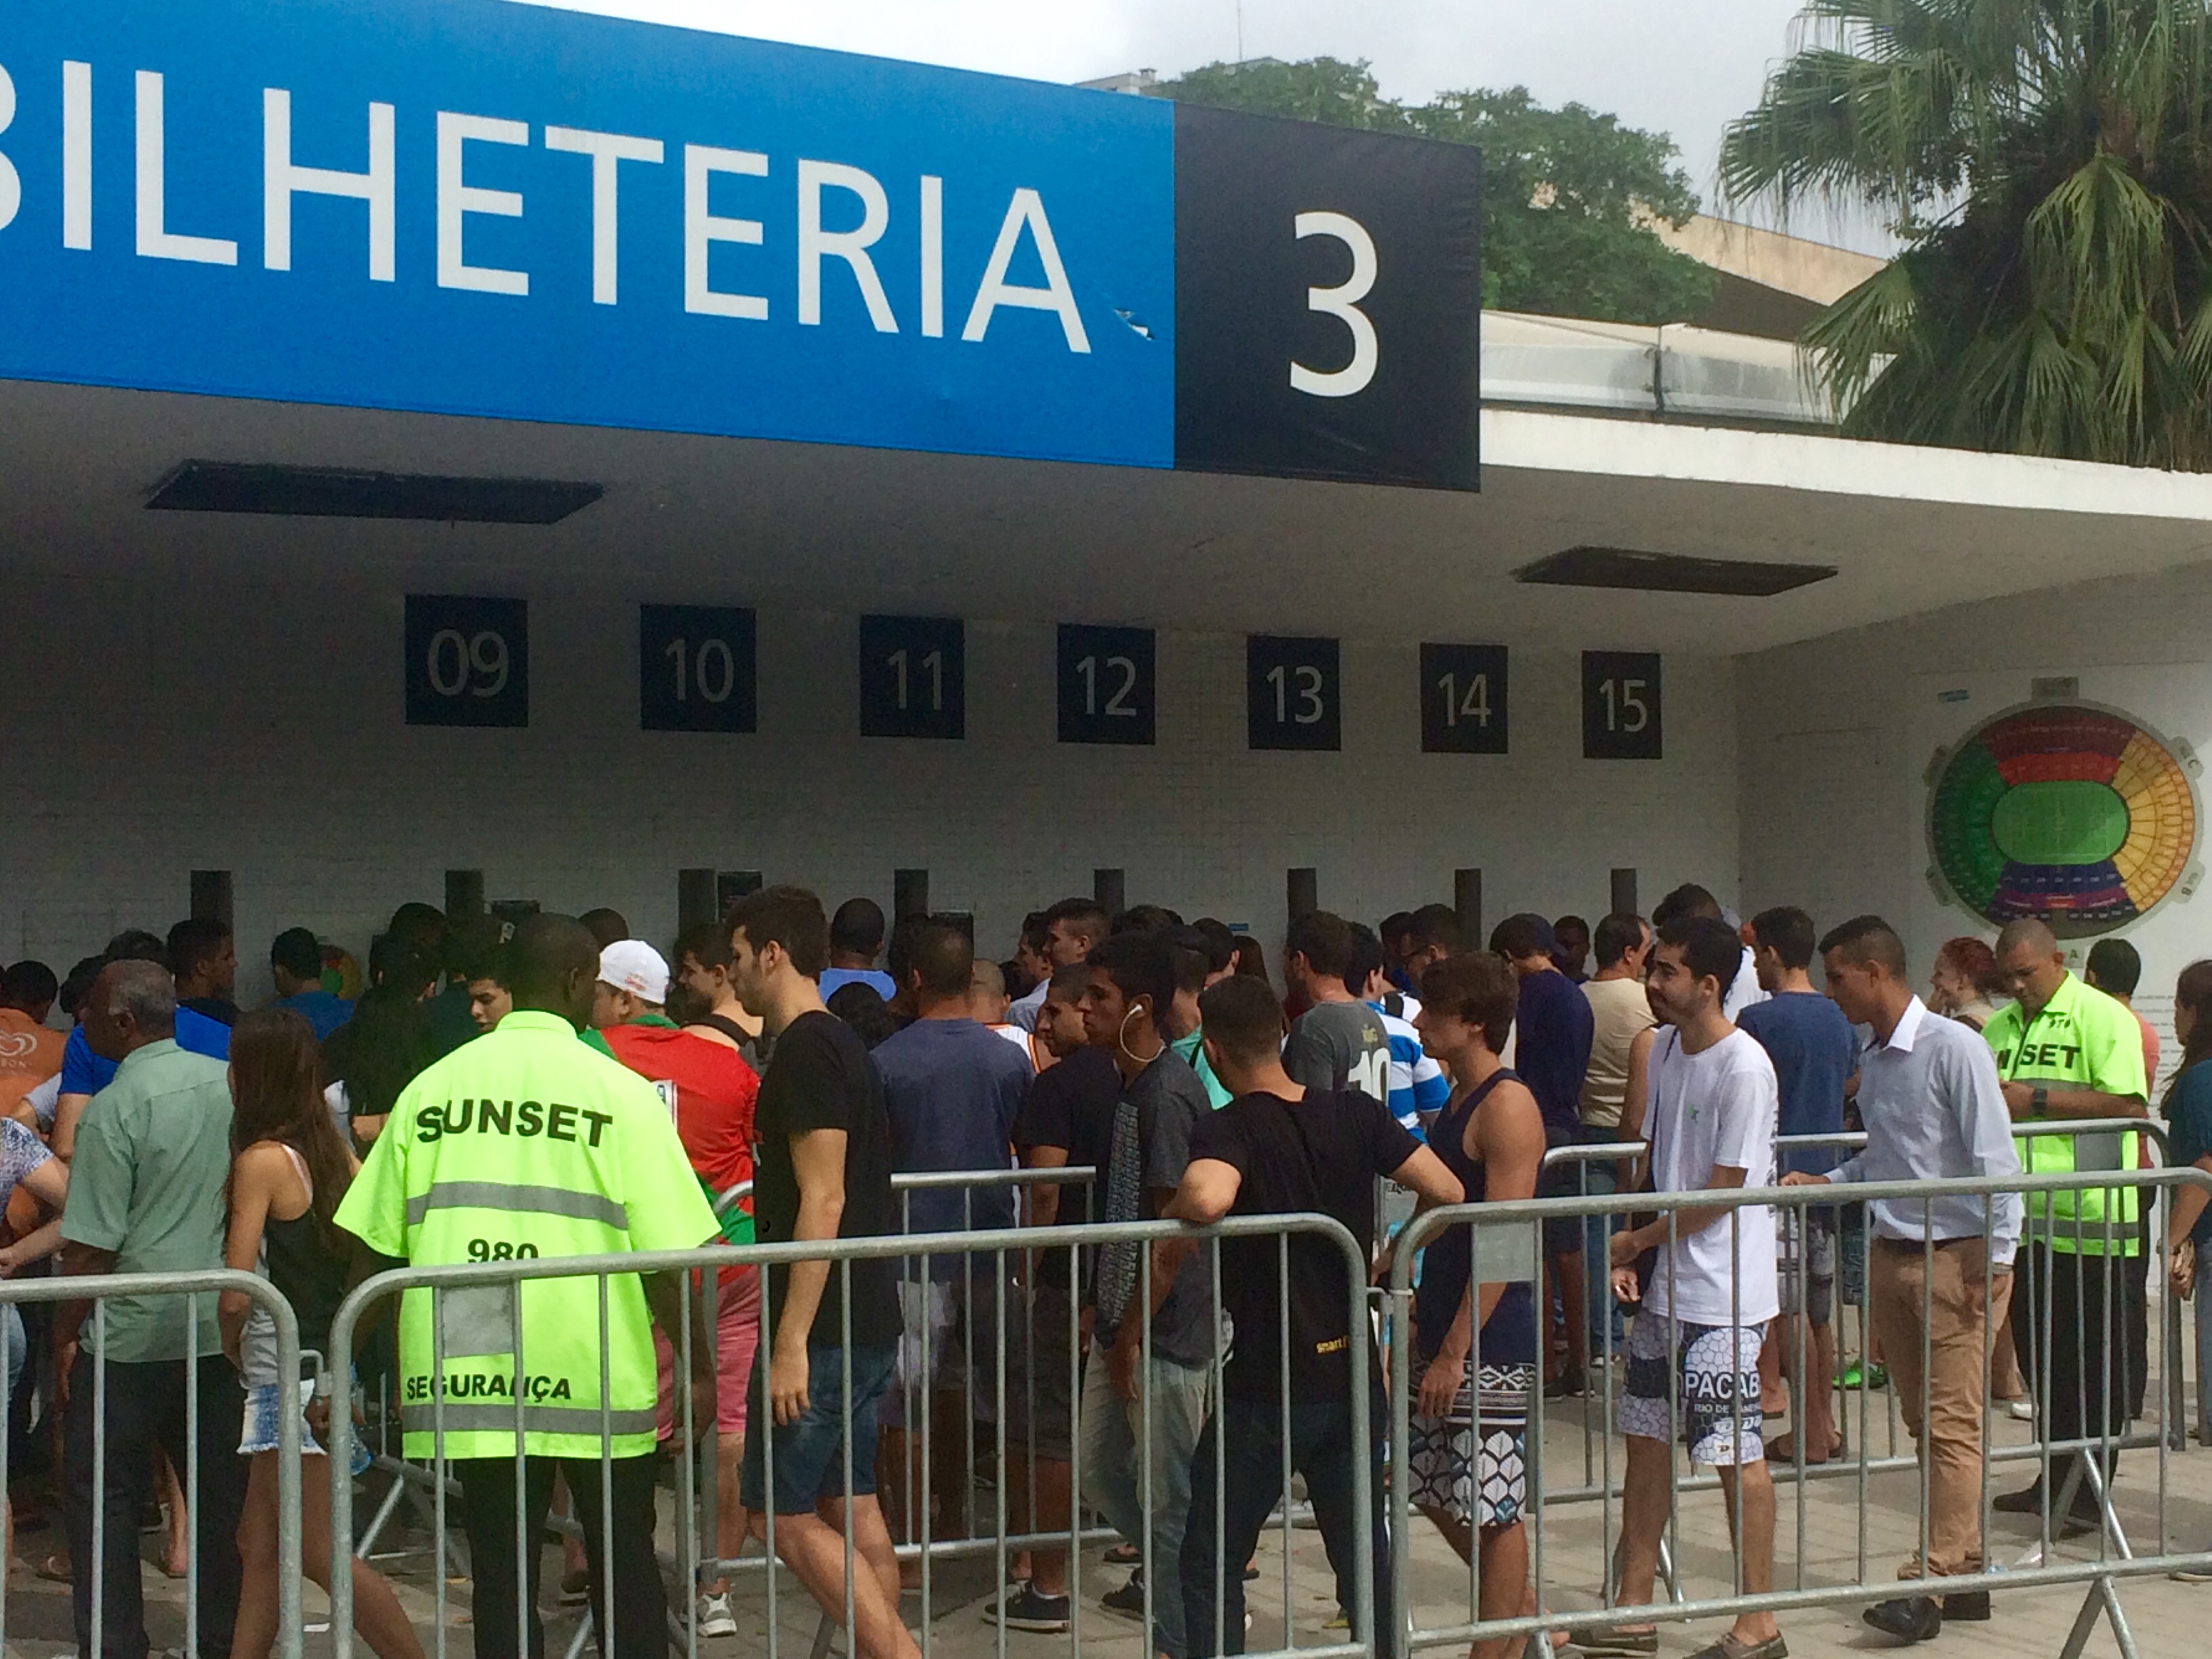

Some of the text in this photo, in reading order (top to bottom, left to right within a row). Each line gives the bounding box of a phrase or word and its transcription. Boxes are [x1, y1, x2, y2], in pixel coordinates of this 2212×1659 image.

[1290, 211, 1378, 398] 3
[428, 629, 510, 697] 09
[665, 638, 734, 703] 10
[887, 649, 943, 710] 11
[1076, 655, 1136, 717] 12
[1266, 665, 1324, 725] 13
[1437, 672, 1491, 727] 14
[1598, 679, 1647, 733] 15
[0, 1058, 26, 1068] BON
[1348, 1048, 1391, 1105] 10
[1997, 1044, 2081, 1069] NSET
[416, 1099, 613, 1148] SUNSET
[468, 1238, 539, 1263] 980
[407, 1374, 571, 1403] SEGURANÇA
[1683, 1371, 1761, 1399] PACAB
[1694, 1403, 1713, 1414] RIO
[1715, 1404, 1730, 1414] DE
